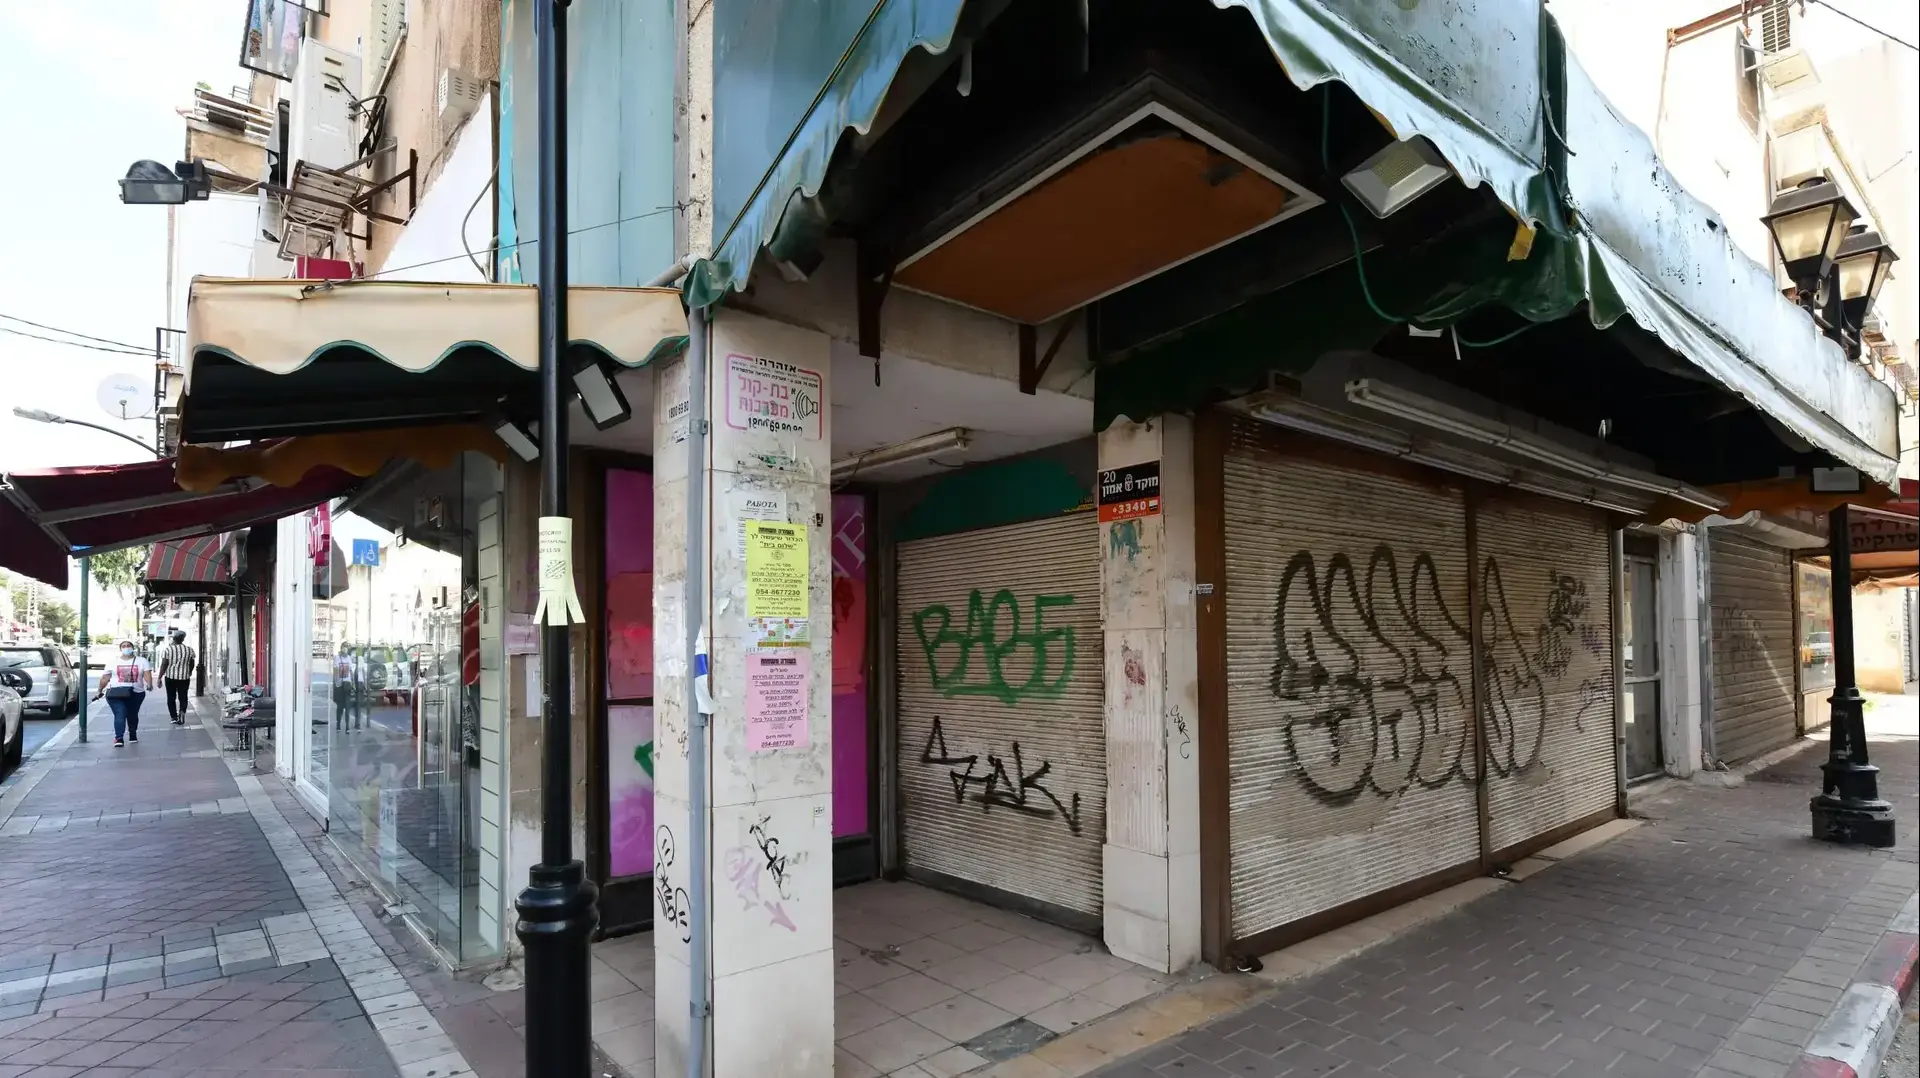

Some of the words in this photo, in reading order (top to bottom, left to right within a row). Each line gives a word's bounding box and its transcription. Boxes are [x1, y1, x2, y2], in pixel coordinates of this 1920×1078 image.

[755, 357, 797, 373] אזהרה!
[738, 375, 789, 400] בת-קול
[668, 405, 678, 419] 1800
[1103, 471, 1116, 483] 20
[1135, 476, 1159, 491] מוקד
[1102, 482, 1123, 498] אמון
[746, 500, 778, 509] РАБОТА
[1852, 533, 1917, 549] סידקית
[756, 588, 800, 596] 054-8677230
